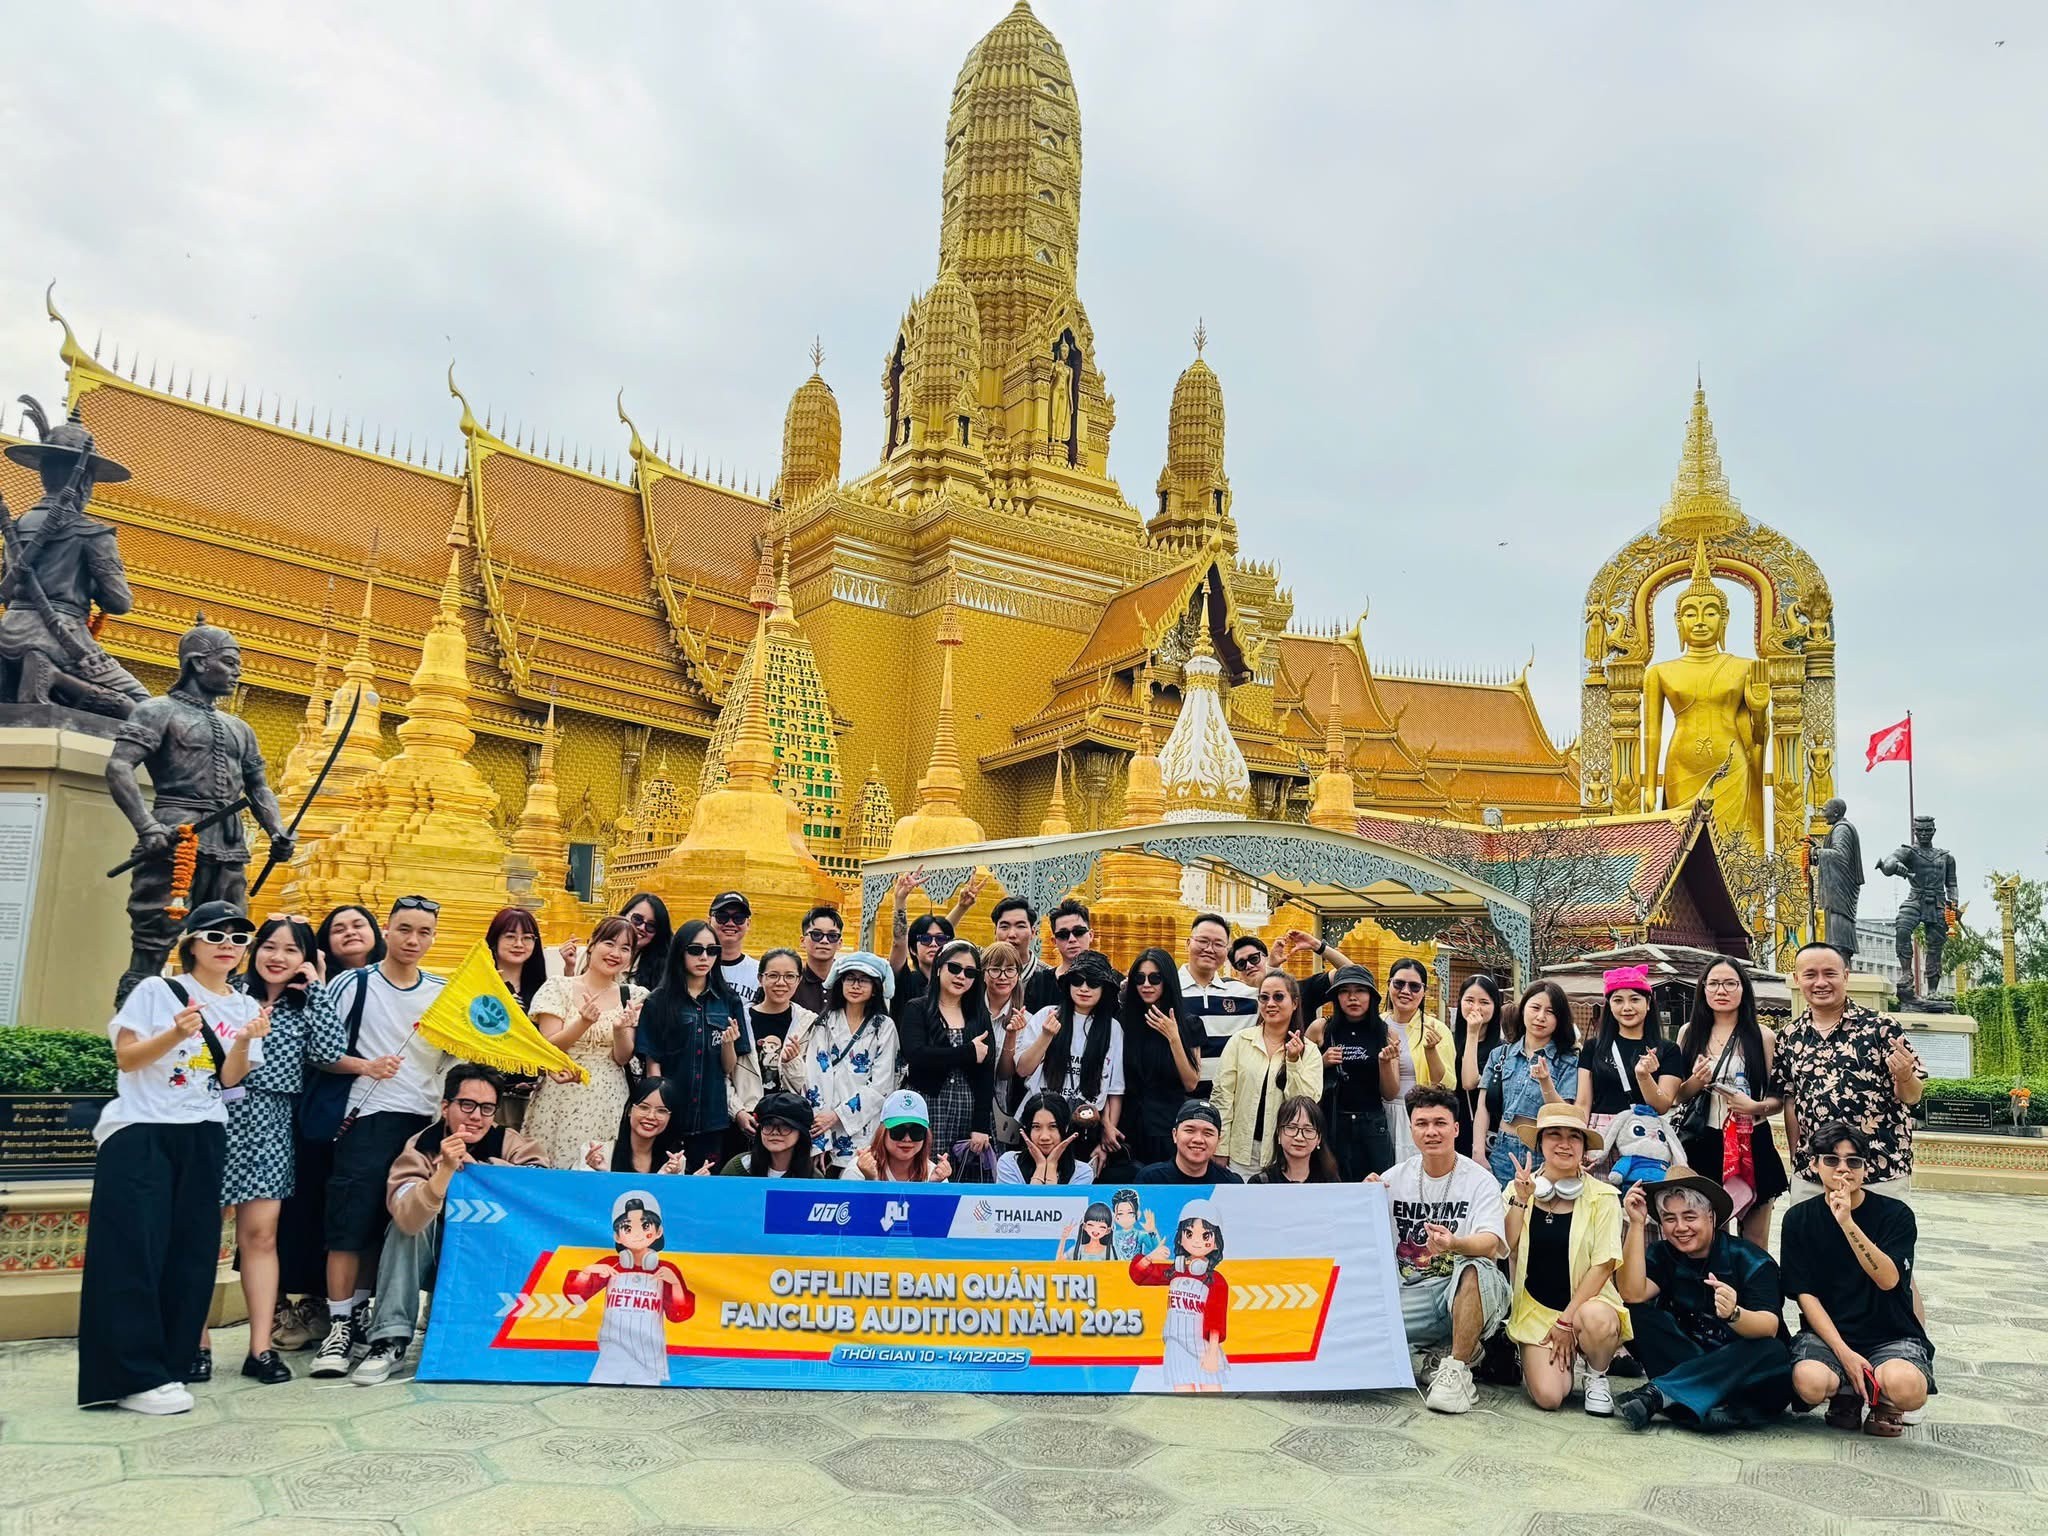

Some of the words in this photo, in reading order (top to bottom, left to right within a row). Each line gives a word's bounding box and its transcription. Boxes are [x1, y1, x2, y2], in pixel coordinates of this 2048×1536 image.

[807, 1202, 851, 1225] VTC
[995, 1209, 1062, 1222] THAILAND
[995, 1223, 1021, 1233] 2025
[611, 1288, 657, 1298] AUDITION
[769, 1268, 891, 1298] OFFLINE
[898, 1273, 956, 1299] BAN
[962, 1266, 1046, 1300] QUẢN
[1051, 1274, 1096, 1308] TRỊ
[607, 1294, 631, 1308] VIET
[633, 1297, 661, 1313] NAM
[720, 1301, 855, 1332] FANCLUB
[861, 1305, 1002, 1334] AUDITION
[1008, 1300, 1075, 1335] NĂM
[1080, 1309, 1143, 1335] 2025
[841, 1347, 875, 1361] THỜI
[878, 1349, 916, 1362] GIAN
[919, 1350, 935, 1362] 10
[948, 1350, 1026, 1364] 14/12/2025
